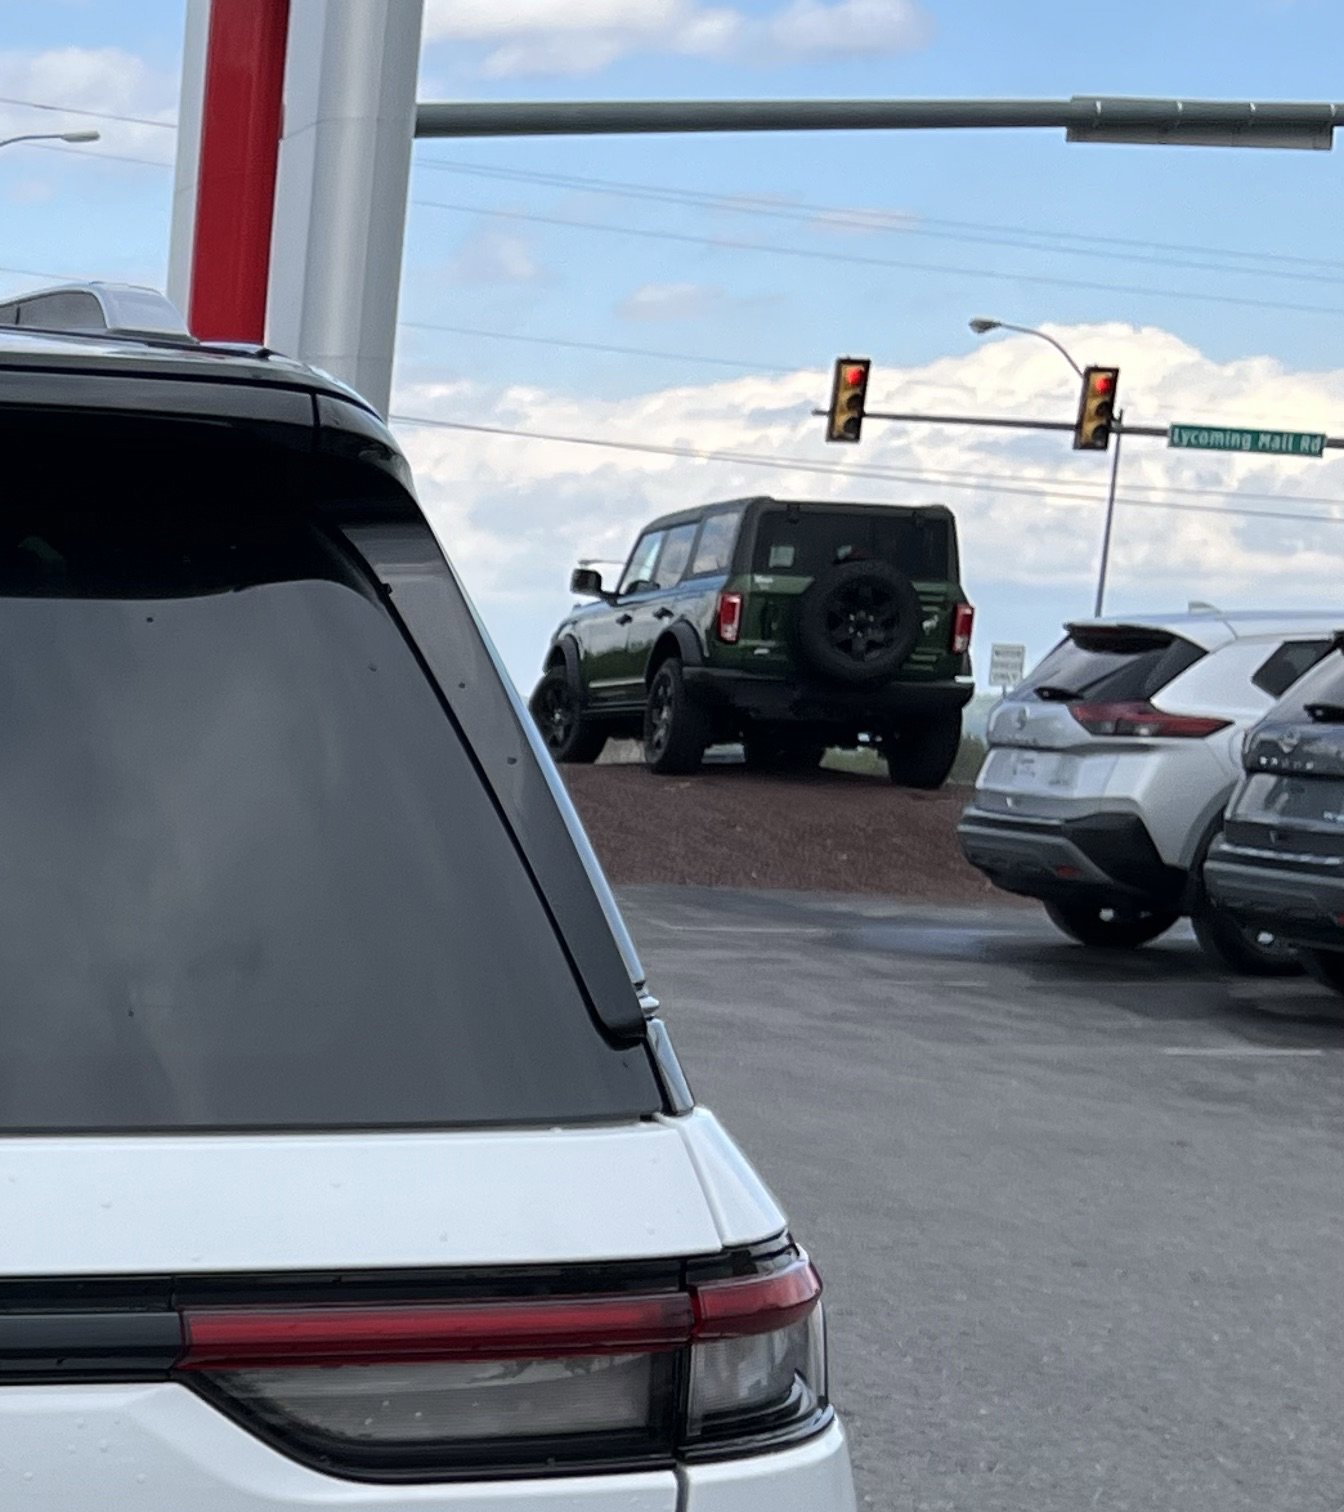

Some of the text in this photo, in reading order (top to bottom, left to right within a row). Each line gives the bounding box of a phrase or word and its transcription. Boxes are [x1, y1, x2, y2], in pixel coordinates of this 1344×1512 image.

[1172, 426, 1322, 454] Lycoming Mall Rd
